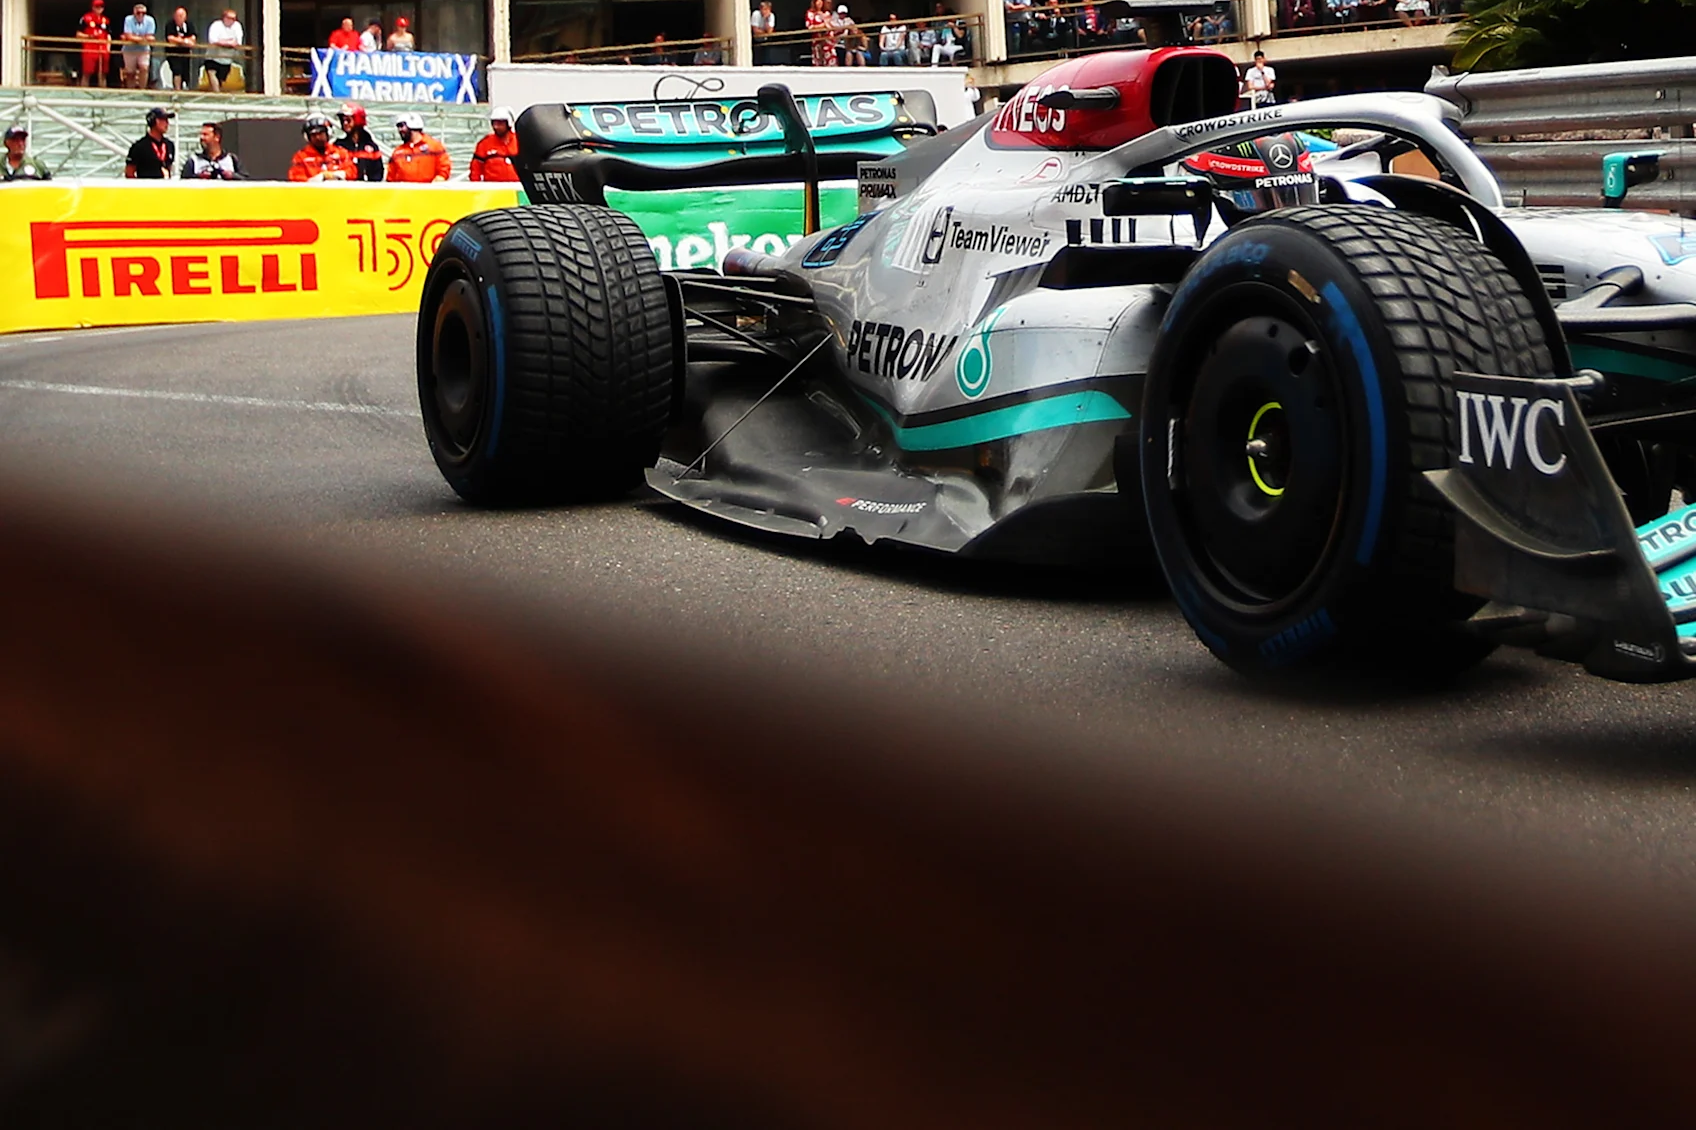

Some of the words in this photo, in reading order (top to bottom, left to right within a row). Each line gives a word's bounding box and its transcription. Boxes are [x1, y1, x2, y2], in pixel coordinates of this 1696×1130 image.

[336, 52, 453, 78] HAMILTON
[346, 80, 445, 103] TARMAC
[994, 85, 1066, 133] INEOS
[1179, 109, 1283, 138] CROWDSTRIKE
[860, 167, 897, 179] PETRONAS
[1211, 160, 1265, 173] CROWDSTRIKE
[545, 172, 584, 201] FTX
[1050, 184, 1085, 203] AMD
[1255, 174, 1313, 188] PETRONAS
[950, 222, 1051, 258] TeamViewer
[30, 218, 319, 300] PIRELLI
[1456, 390, 1567, 475] IWC
[851, 499, 927, 514] PERFORMANCE
